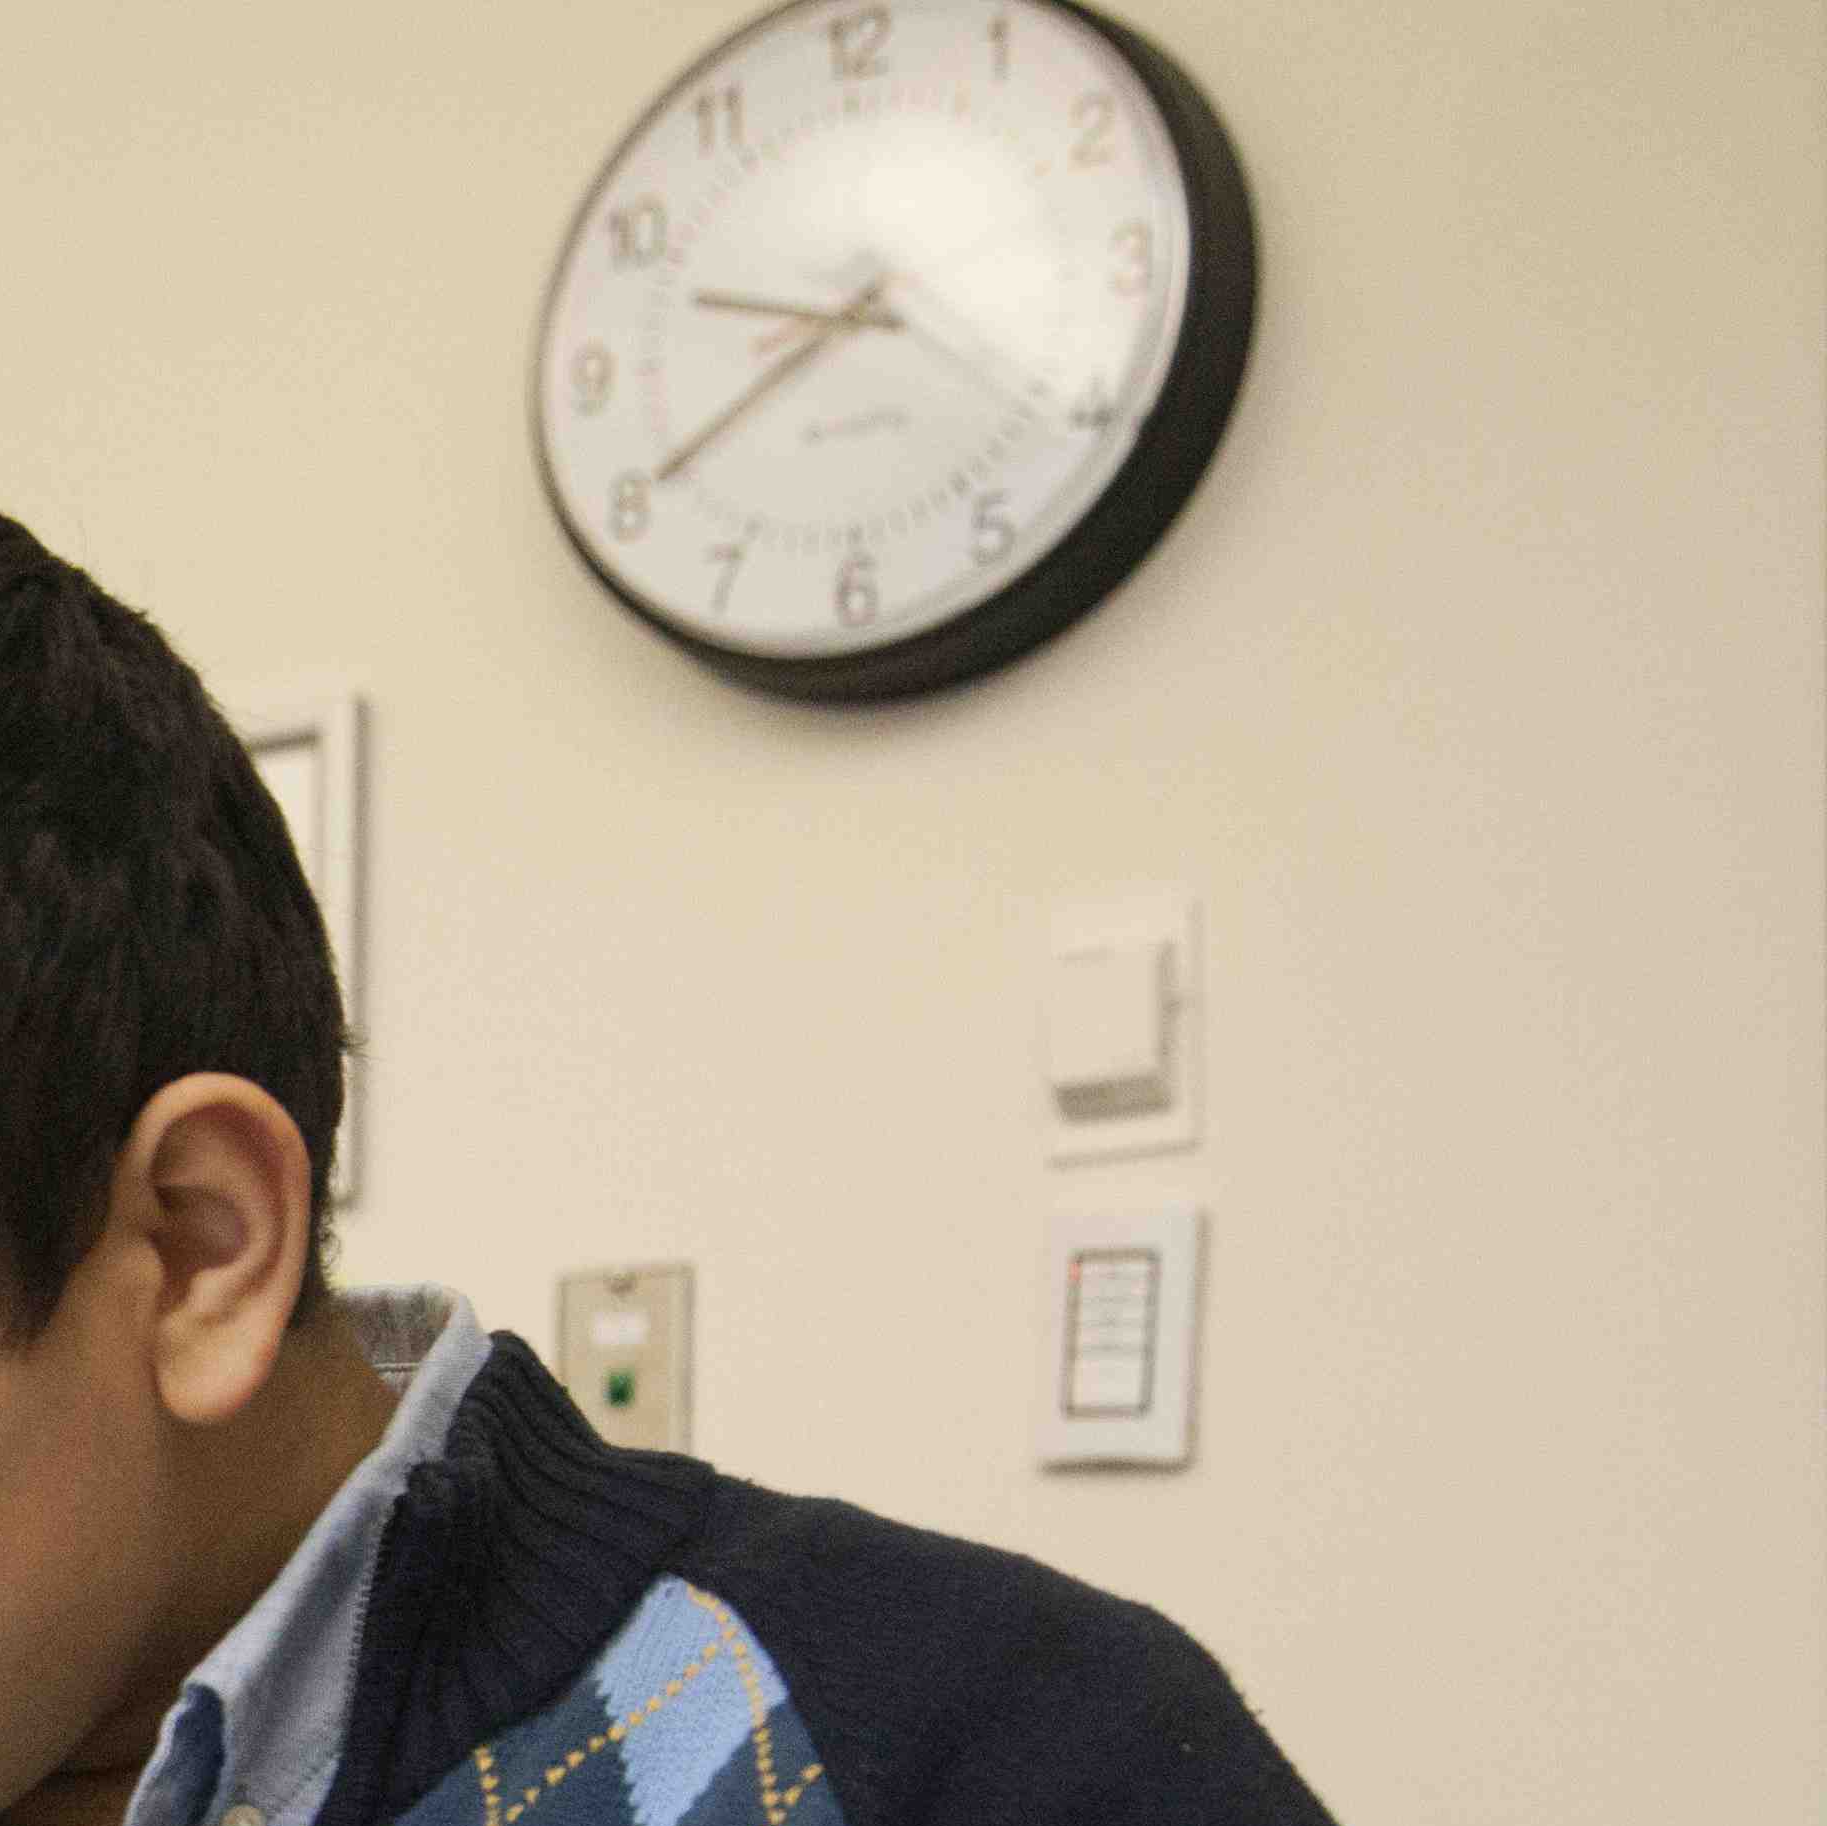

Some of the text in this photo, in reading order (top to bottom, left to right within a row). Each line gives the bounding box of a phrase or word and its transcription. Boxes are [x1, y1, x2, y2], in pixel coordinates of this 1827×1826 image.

[827, 7, 891, 80] 12
[988, 12, 1012, 81] 1
[693, 88, 749, 156] 11
[1070, 95, 1115, 169] 2
[608, 197, 669, 270] 10
[1110, 222, 1154, 297] 3
[572, 345, 613, 414] 9
[607, 470, 650, 541] 8
[970, 492, 1015, 566] 5
[705, 544, 743, 614] 7
[835, 553, 879, 628] 6
